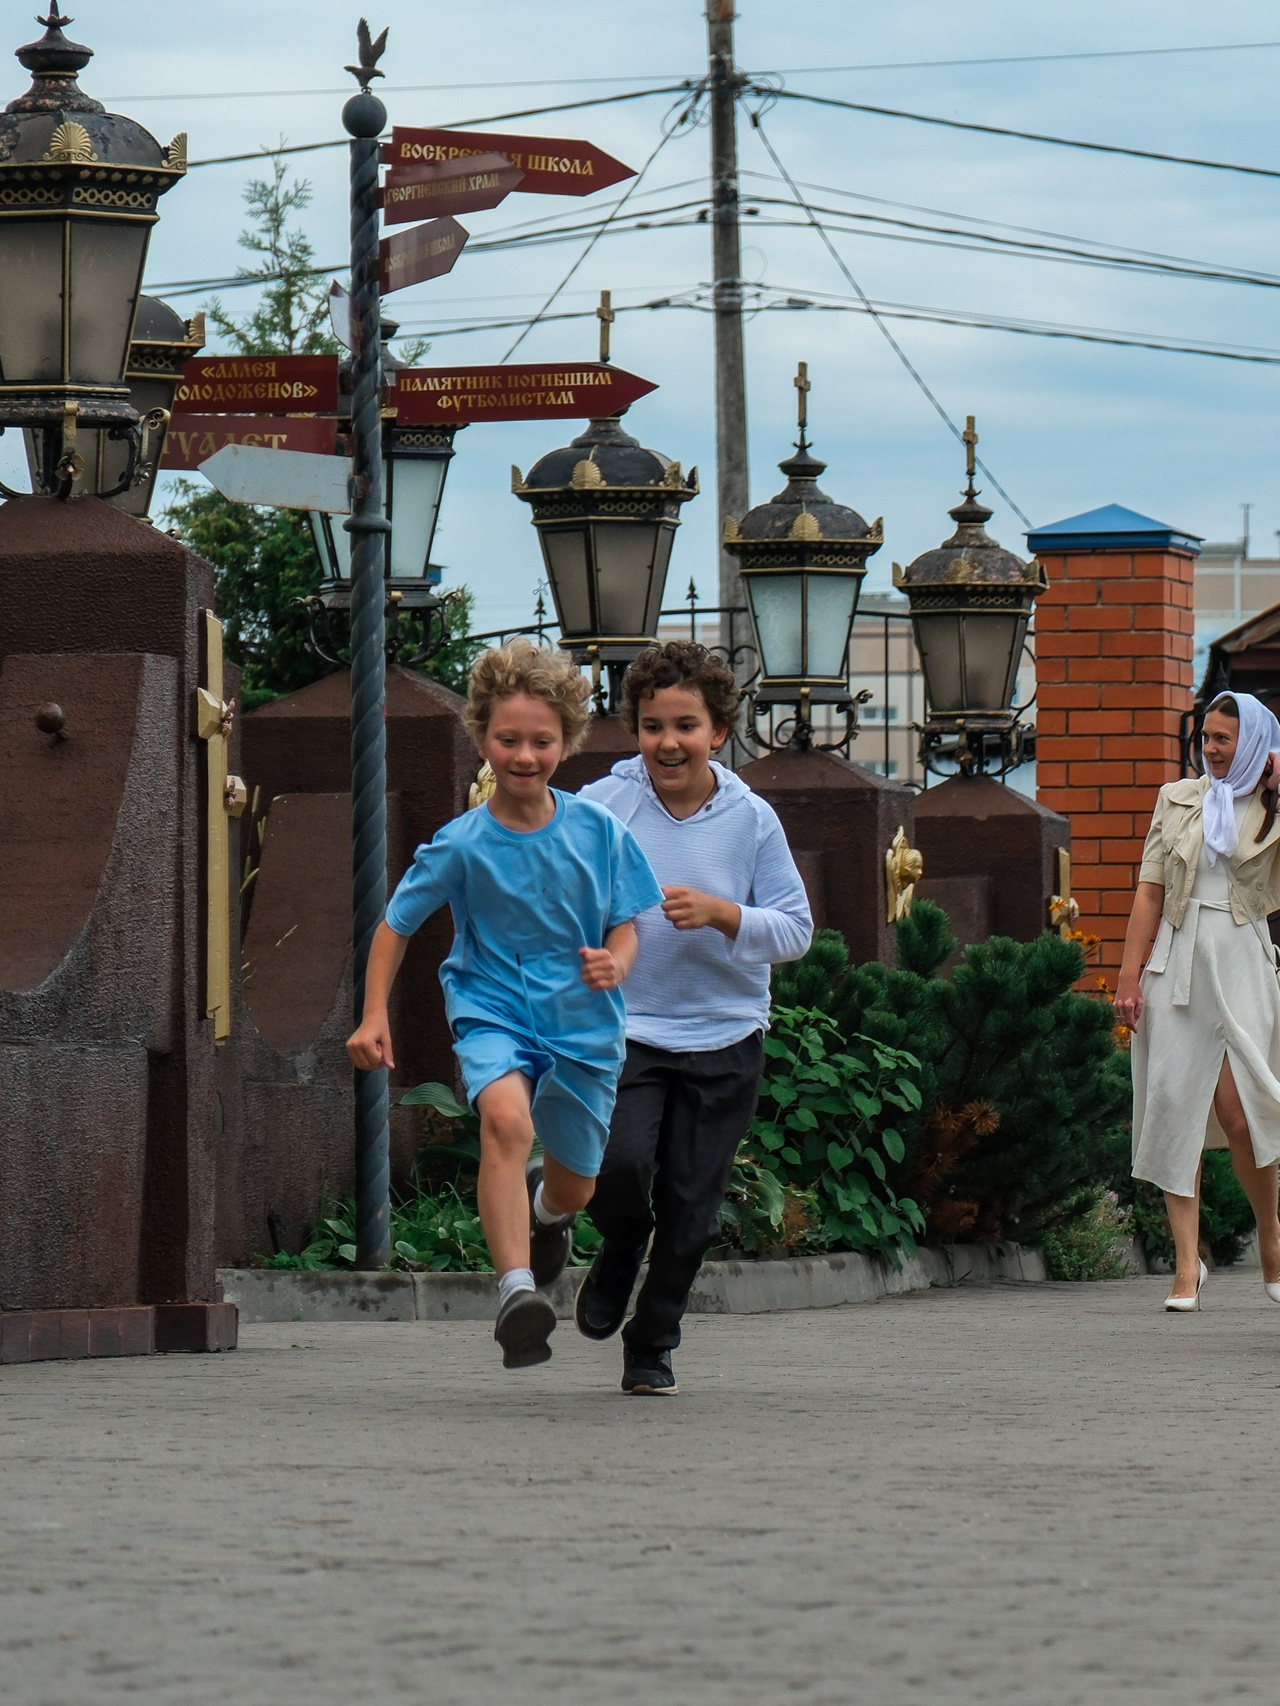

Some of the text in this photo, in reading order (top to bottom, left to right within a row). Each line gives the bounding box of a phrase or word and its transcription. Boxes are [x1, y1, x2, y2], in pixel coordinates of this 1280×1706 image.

[400, 142, 595, 176] ВОСКРЕЯ ШКОЛА
[387, 172, 500, 203] ГЕОРГИЕВСКИЙ ХРАМ
[201, 361, 278, 379] «АЛЛЕЯ
[174, 381, 319, 402] ОЛОДОЖЕНОВ»
[400, 371, 614, 392] ПАМЯТНИК ПОГИБШИМ
[437, 391, 576, 412] ФУТБОЛИСТАМ
